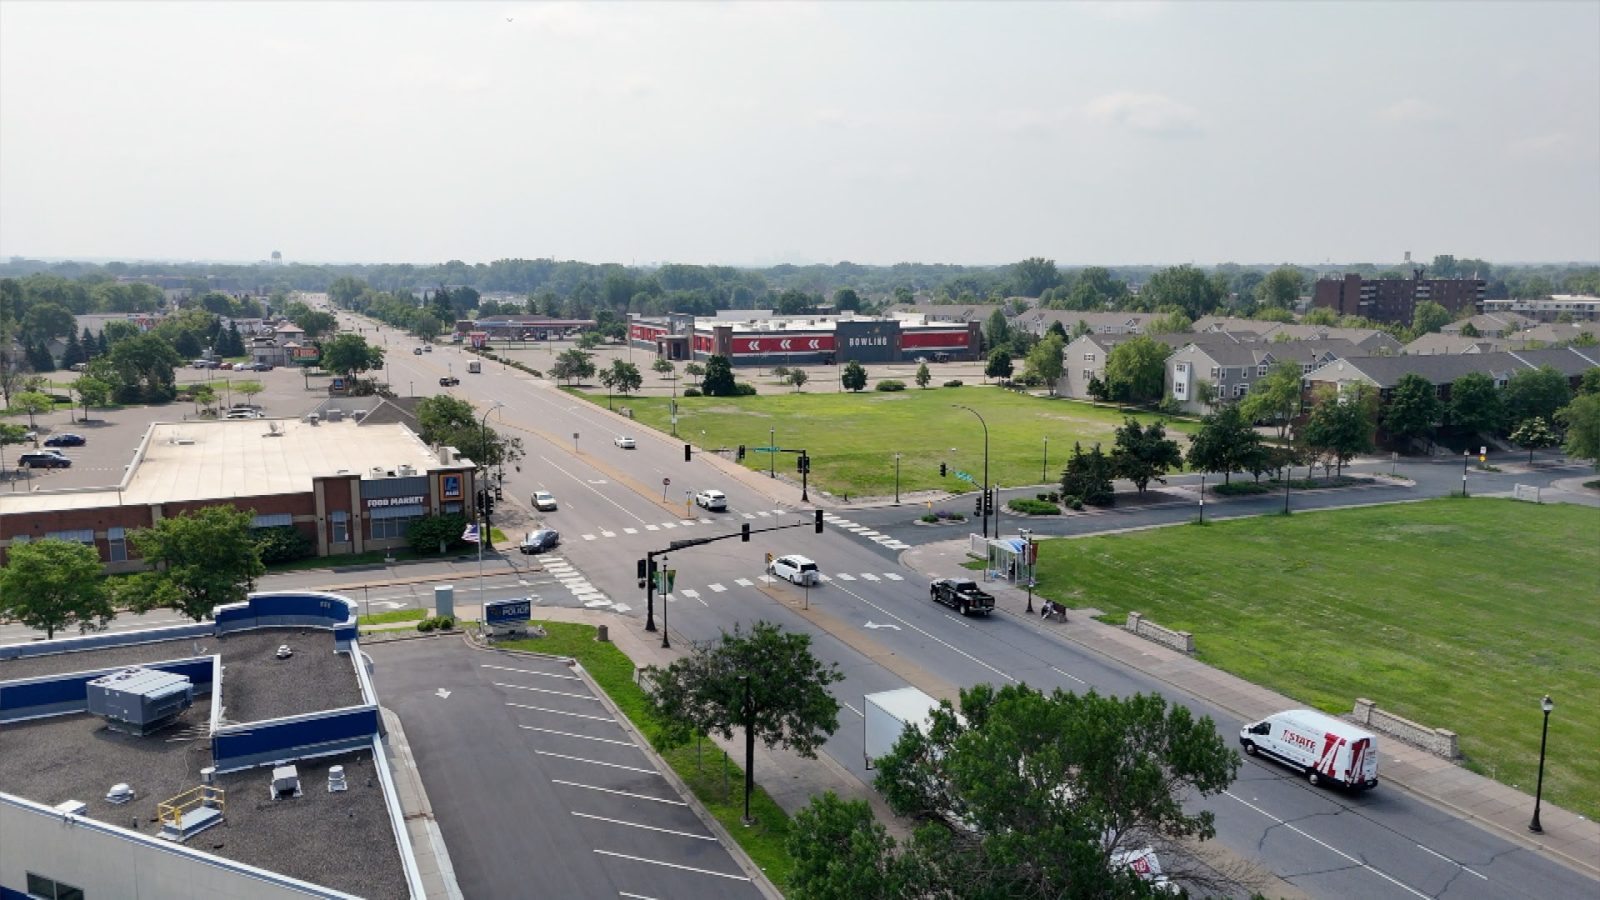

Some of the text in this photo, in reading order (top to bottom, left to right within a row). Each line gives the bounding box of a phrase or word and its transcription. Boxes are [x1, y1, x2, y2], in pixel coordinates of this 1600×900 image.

[849, 336, 887, 346] BOWLING
[367, 496, 424, 507] FOOD MARKET
[502, 605, 529, 616] POLICE
